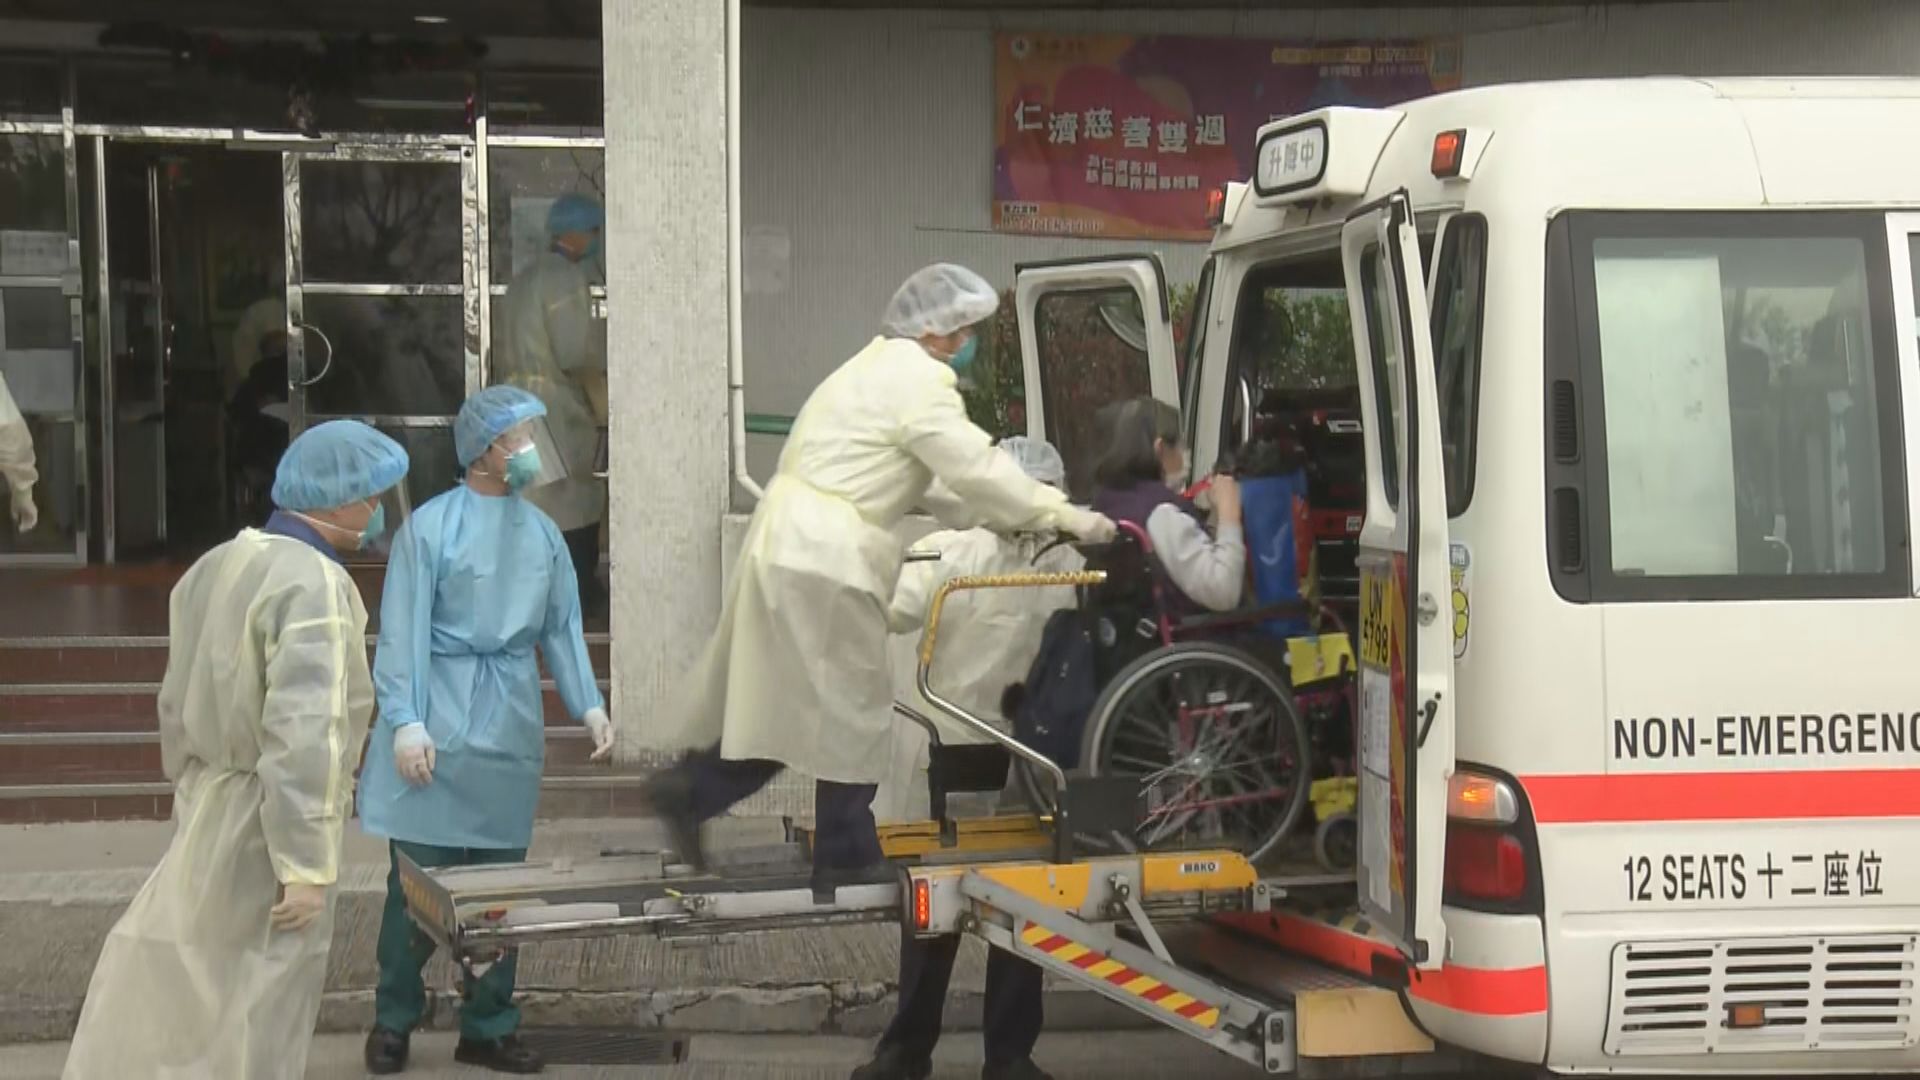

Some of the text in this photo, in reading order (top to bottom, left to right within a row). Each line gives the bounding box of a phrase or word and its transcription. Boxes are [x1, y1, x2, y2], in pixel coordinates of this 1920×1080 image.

[1014, 100, 1227, 153] 仁濟慈善雙週
[1363, 617, 1389, 664] 5798
[1624, 850, 1883, 901] 12 SEATS 十二座位
